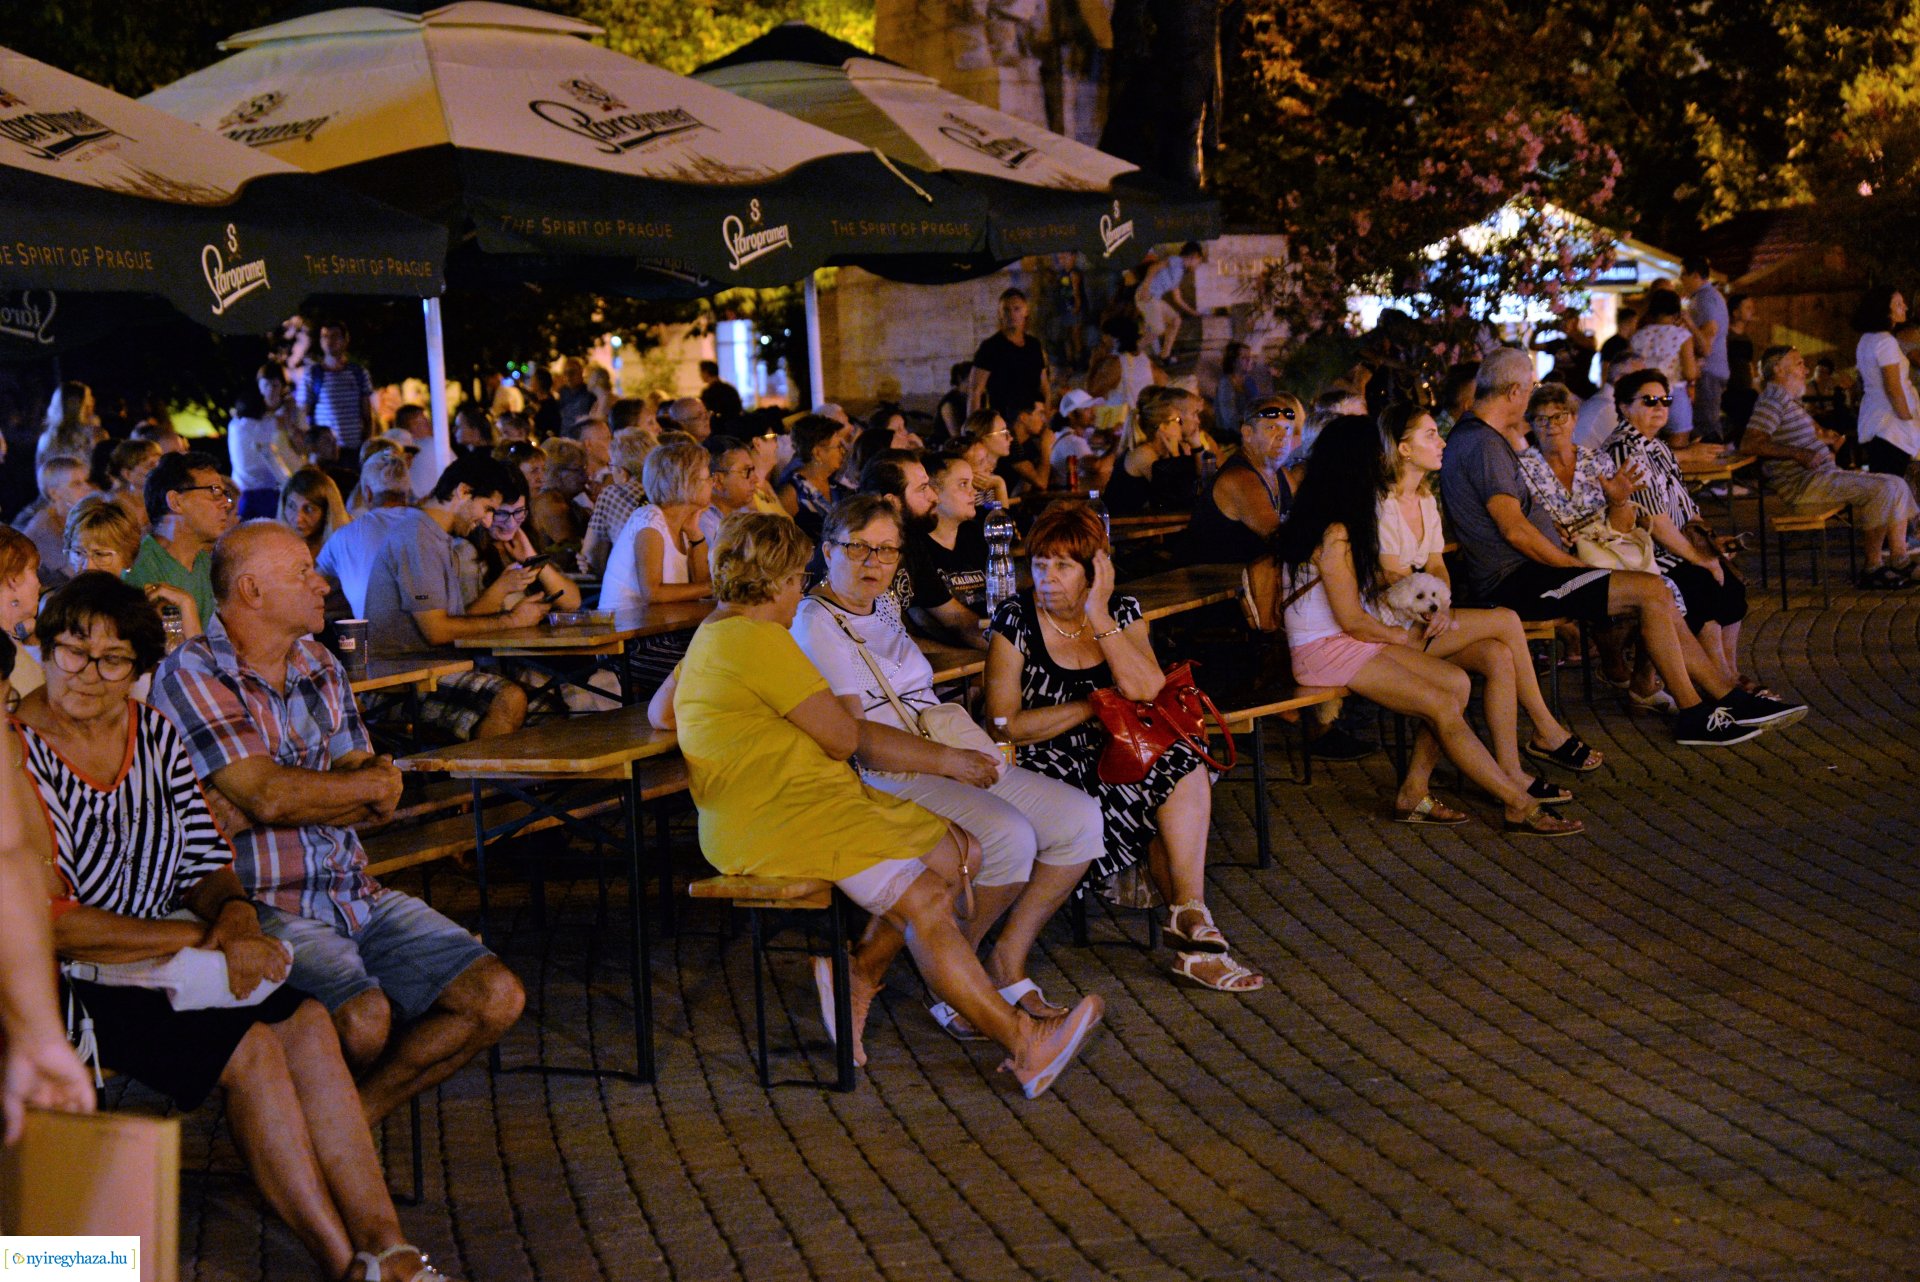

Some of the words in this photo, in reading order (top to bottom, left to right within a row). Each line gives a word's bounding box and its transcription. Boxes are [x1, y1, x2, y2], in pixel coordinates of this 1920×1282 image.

[529, 100, 721, 154] Staropramen
[541, 216, 588, 236] SPIRIT
[615, 218, 673, 240] PRAGUE
[722, 214, 793, 271] Staropramen
[16, 241, 67, 267] SPIRIT
[71, 247, 90, 268] OF
[95, 245, 154, 271] PRAGUE
[331, 255, 367, 276] SPIRIT
[387, 257, 433, 278] PRAGUE
[202, 243, 272, 316] Staropramen
